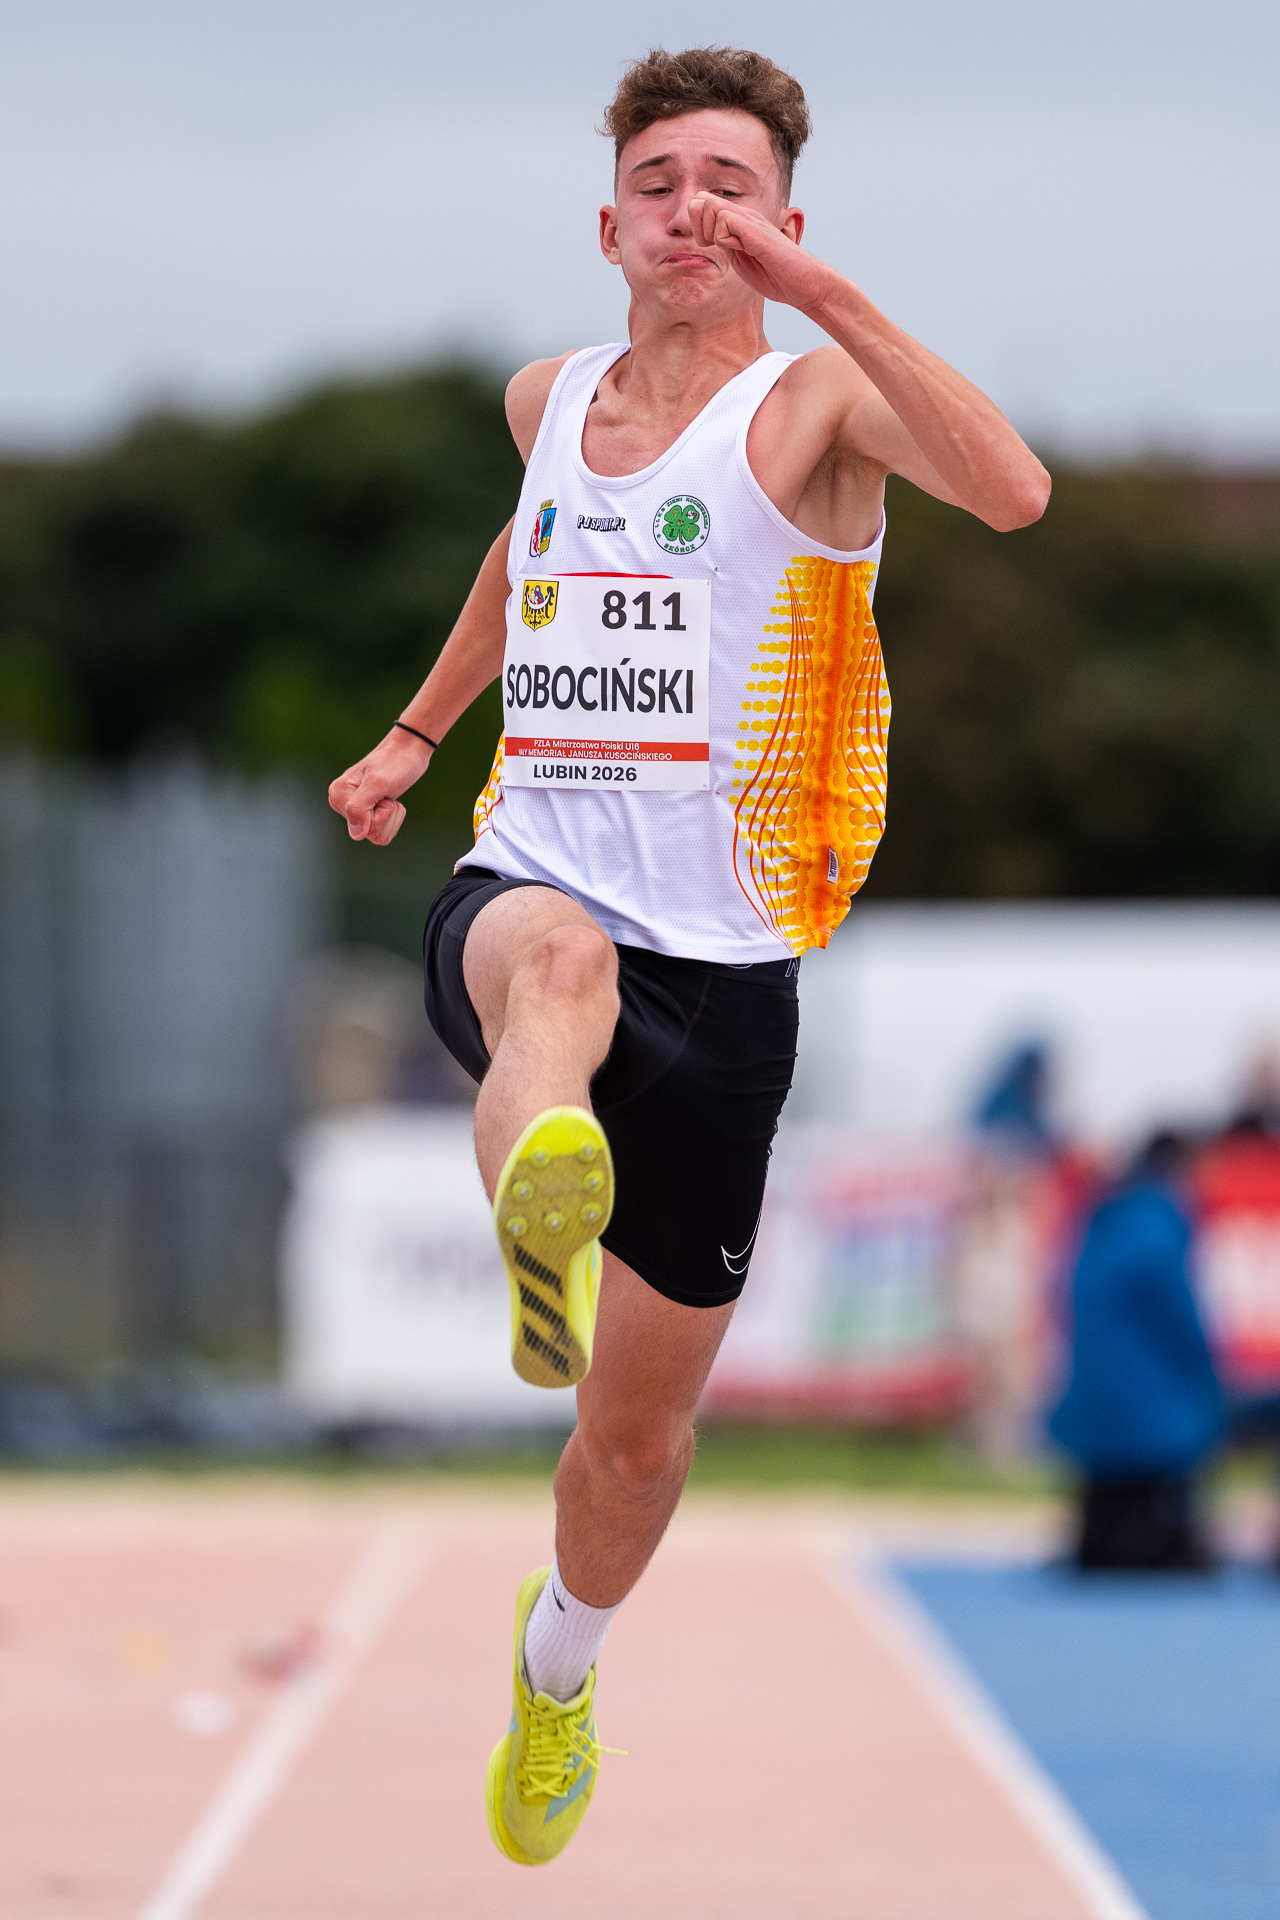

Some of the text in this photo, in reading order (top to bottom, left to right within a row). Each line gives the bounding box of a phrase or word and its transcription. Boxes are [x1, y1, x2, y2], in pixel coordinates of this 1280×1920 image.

[664, 543, 696, 553] SKÓRCZ
[601, 590, 687, 631] 811
[507, 657, 693, 714] SOBOCIŃSKI
[533, 739, 640, 751] PZLA Mistrzostwa Polski U16
[528, 748, 567, 758] MEMORIAŁ
[568, 750, 603, 759] JANUSZA
[604, 751, 673, 761] KUSOCIŃSKIEGO
[533, 764, 638, 782] LUBIN 2026
